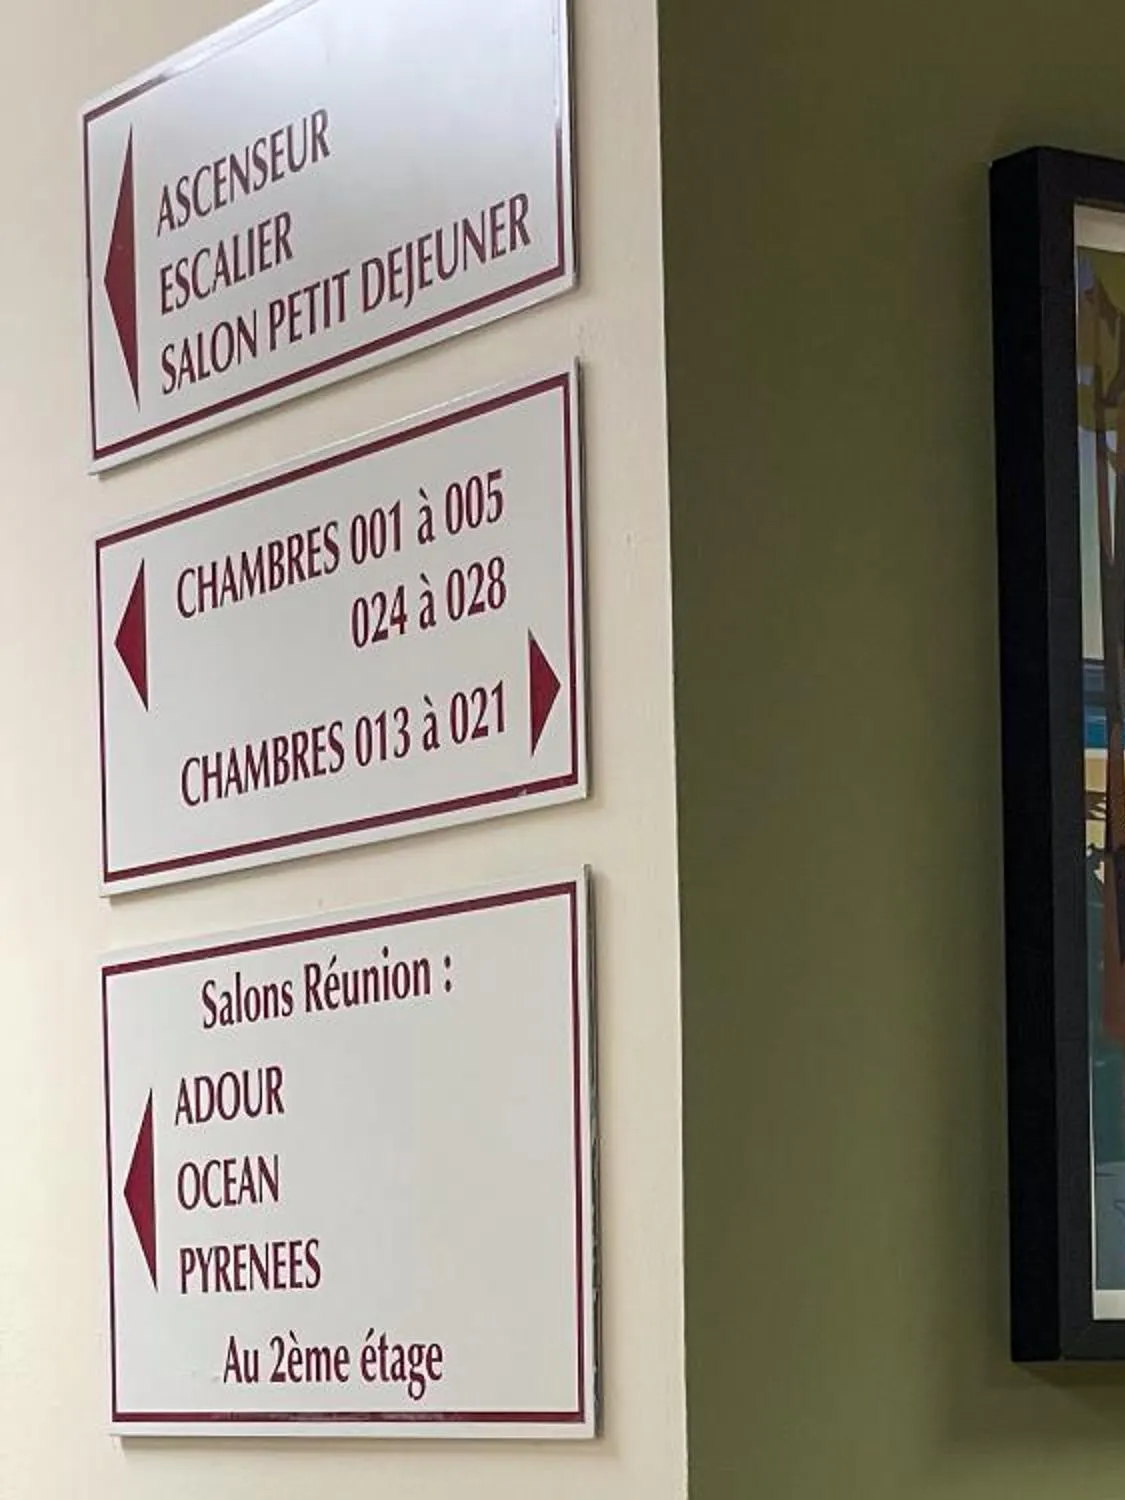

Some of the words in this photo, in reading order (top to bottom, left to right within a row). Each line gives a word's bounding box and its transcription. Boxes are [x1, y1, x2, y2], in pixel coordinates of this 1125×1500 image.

[156, 108, 331, 236] ASCENSEUR
[160, 210, 294, 315] ESCALIER
[161, 309, 257, 395] SALON
[268, 269, 351, 351] PETIT
[360, 192, 531, 313] DEJEUNER
[177, 520, 341, 618] CHAMBRES
[350, 499, 403, 565] 001
[416, 487, 436, 545] à
[445, 469, 505, 535] 005
[351, 584, 409, 649] 024
[418, 573, 437, 630] à
[446, 556, 508, 622] 028
[181, 720, 345, 807] CHAMBRES
[354, 706, 411, 767] 013
[422, 694, 441, 753] à
[450, 680, 506, 744] 021
[201, 970, 294, 1030] Salons
[303, 945, 432, 1013] Réunion
[174, 1065, 285, 1127] ADOUR
[177, 1154, 280, 1211] OCEAN
[179, 1238, 322, 1295] PYRENEES
[223, 1335, 259, 1385] Au
[269, 1329, 350, 1385] 2ème
[360, 1327, 444, 1401] étage
